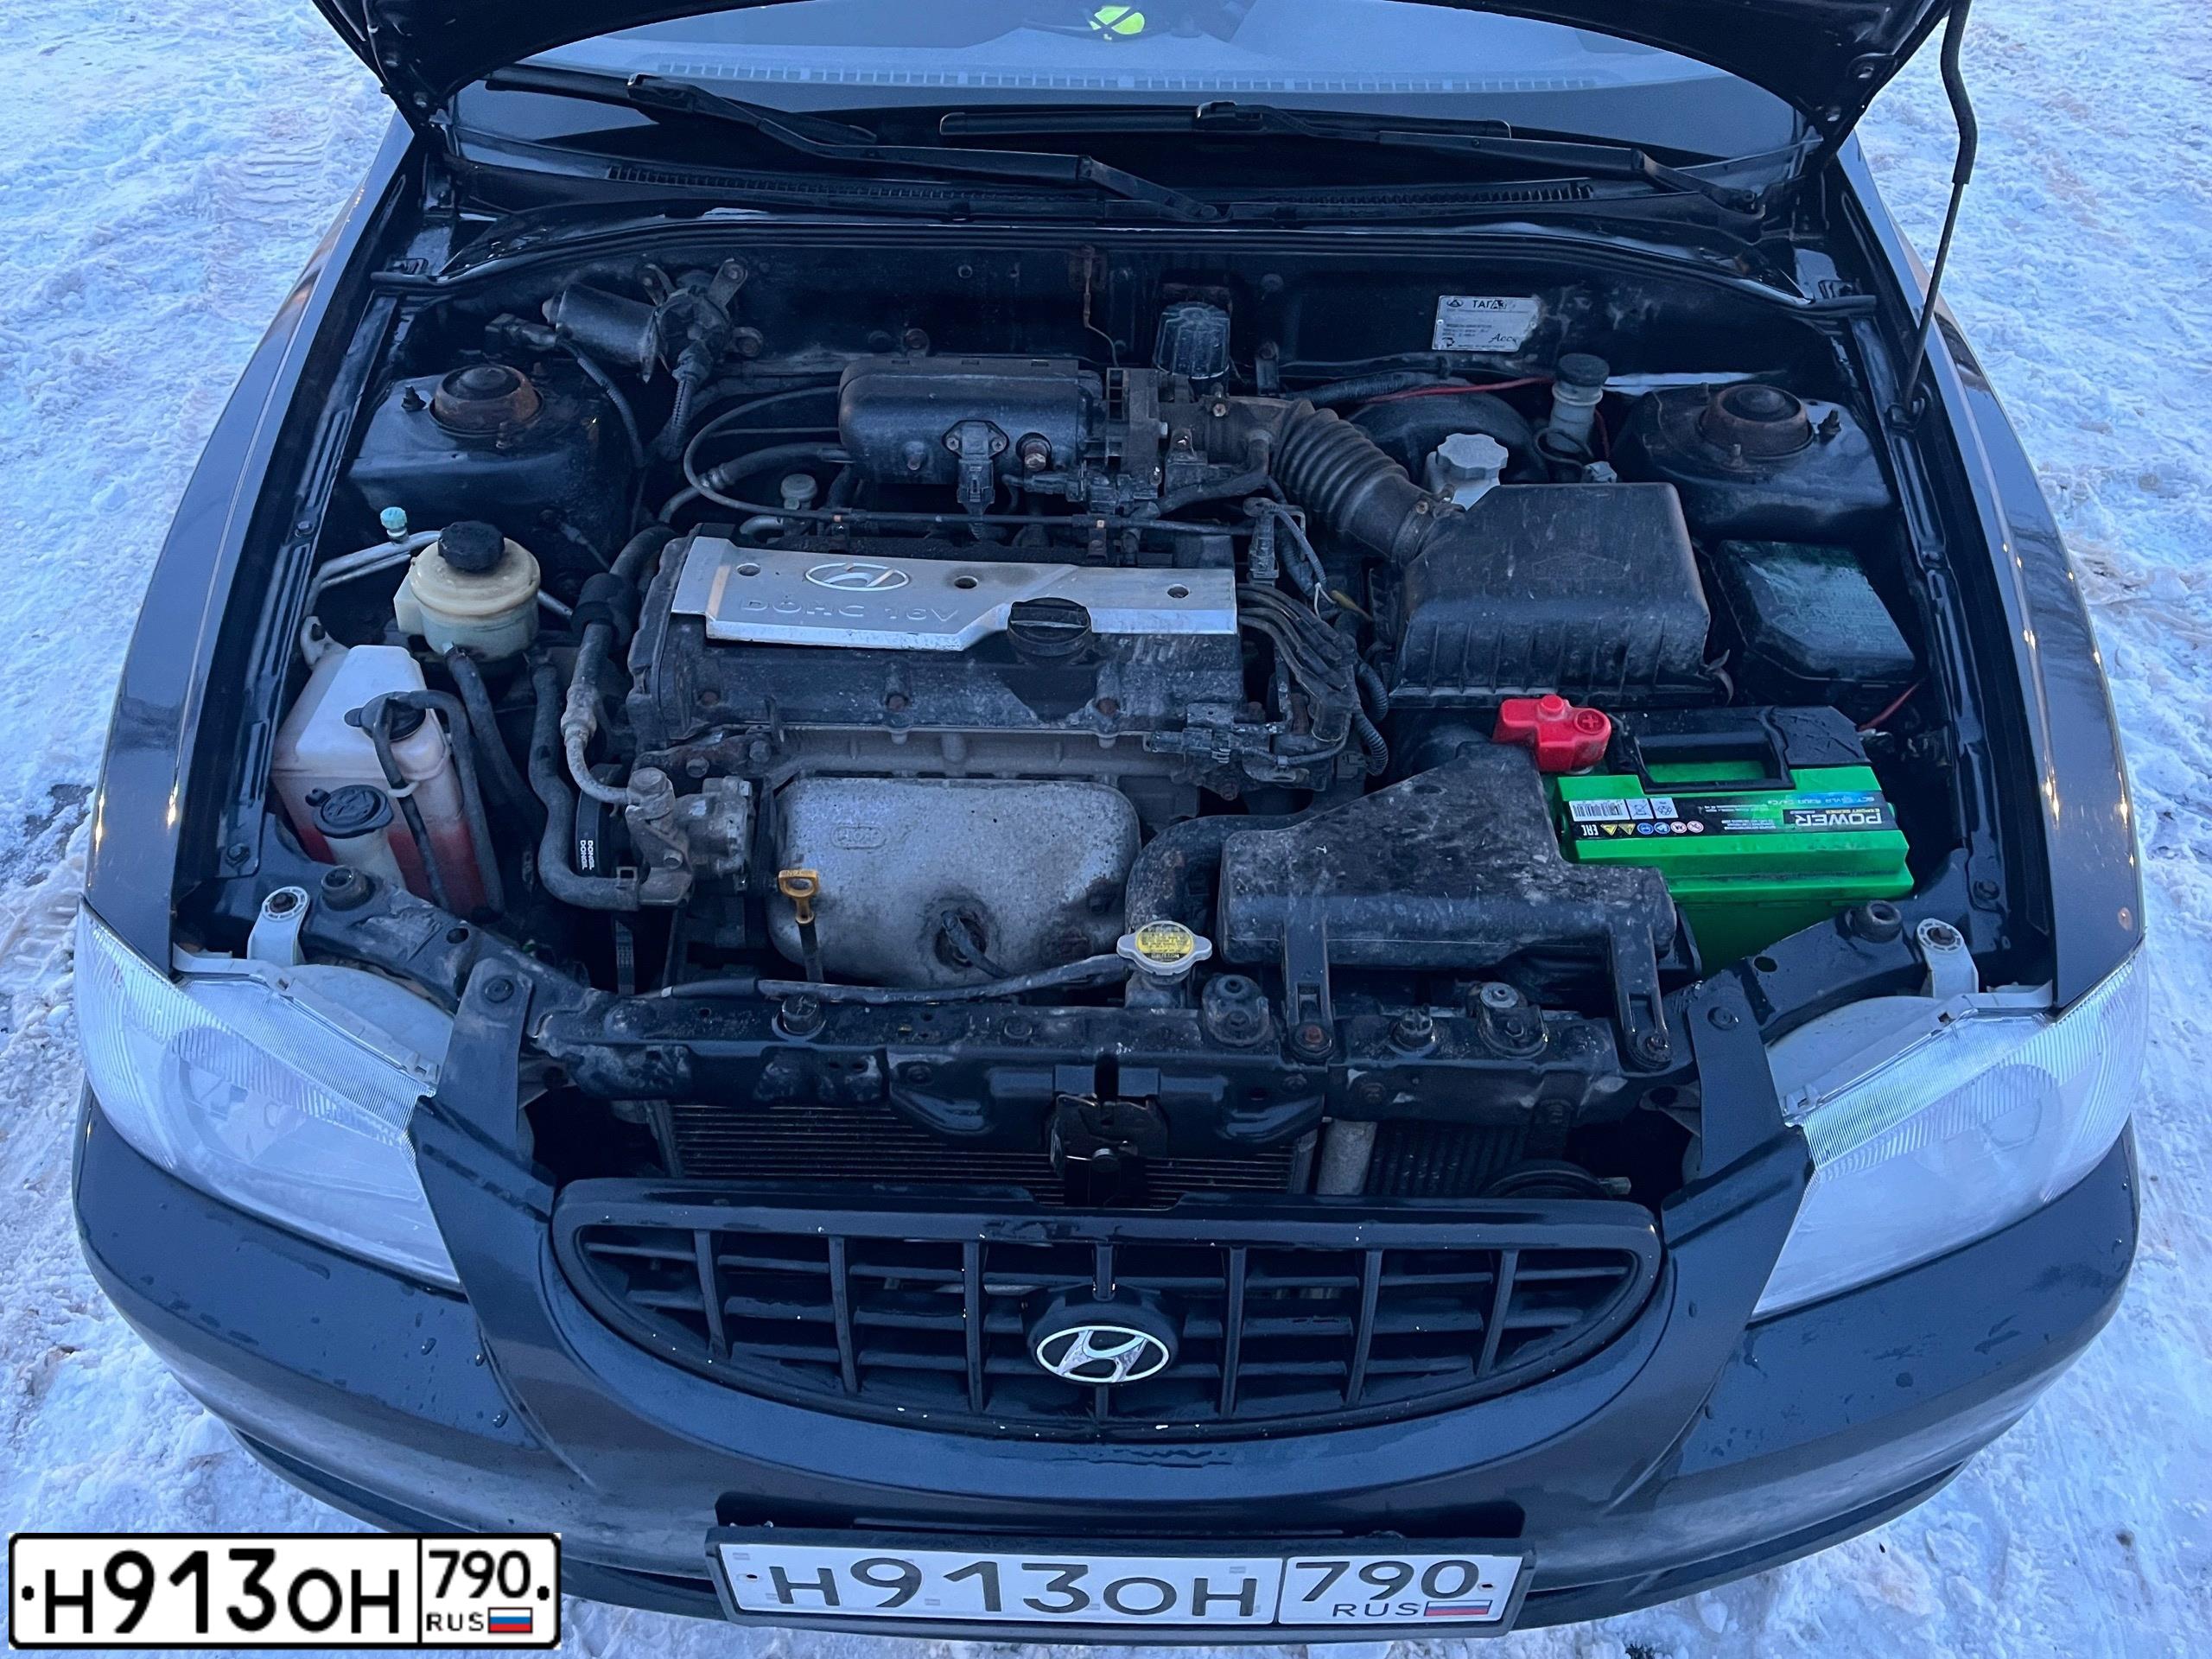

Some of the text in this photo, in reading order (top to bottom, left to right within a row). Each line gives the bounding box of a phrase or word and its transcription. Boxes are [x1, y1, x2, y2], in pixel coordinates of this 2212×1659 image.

[741, 600, 959, 621] DOHC 16V
[1795, 813, 1883, 827] POWER
[1296, 1560, 1480, 1602] 790
[1332, 1602, 1419, 1618] RUS
